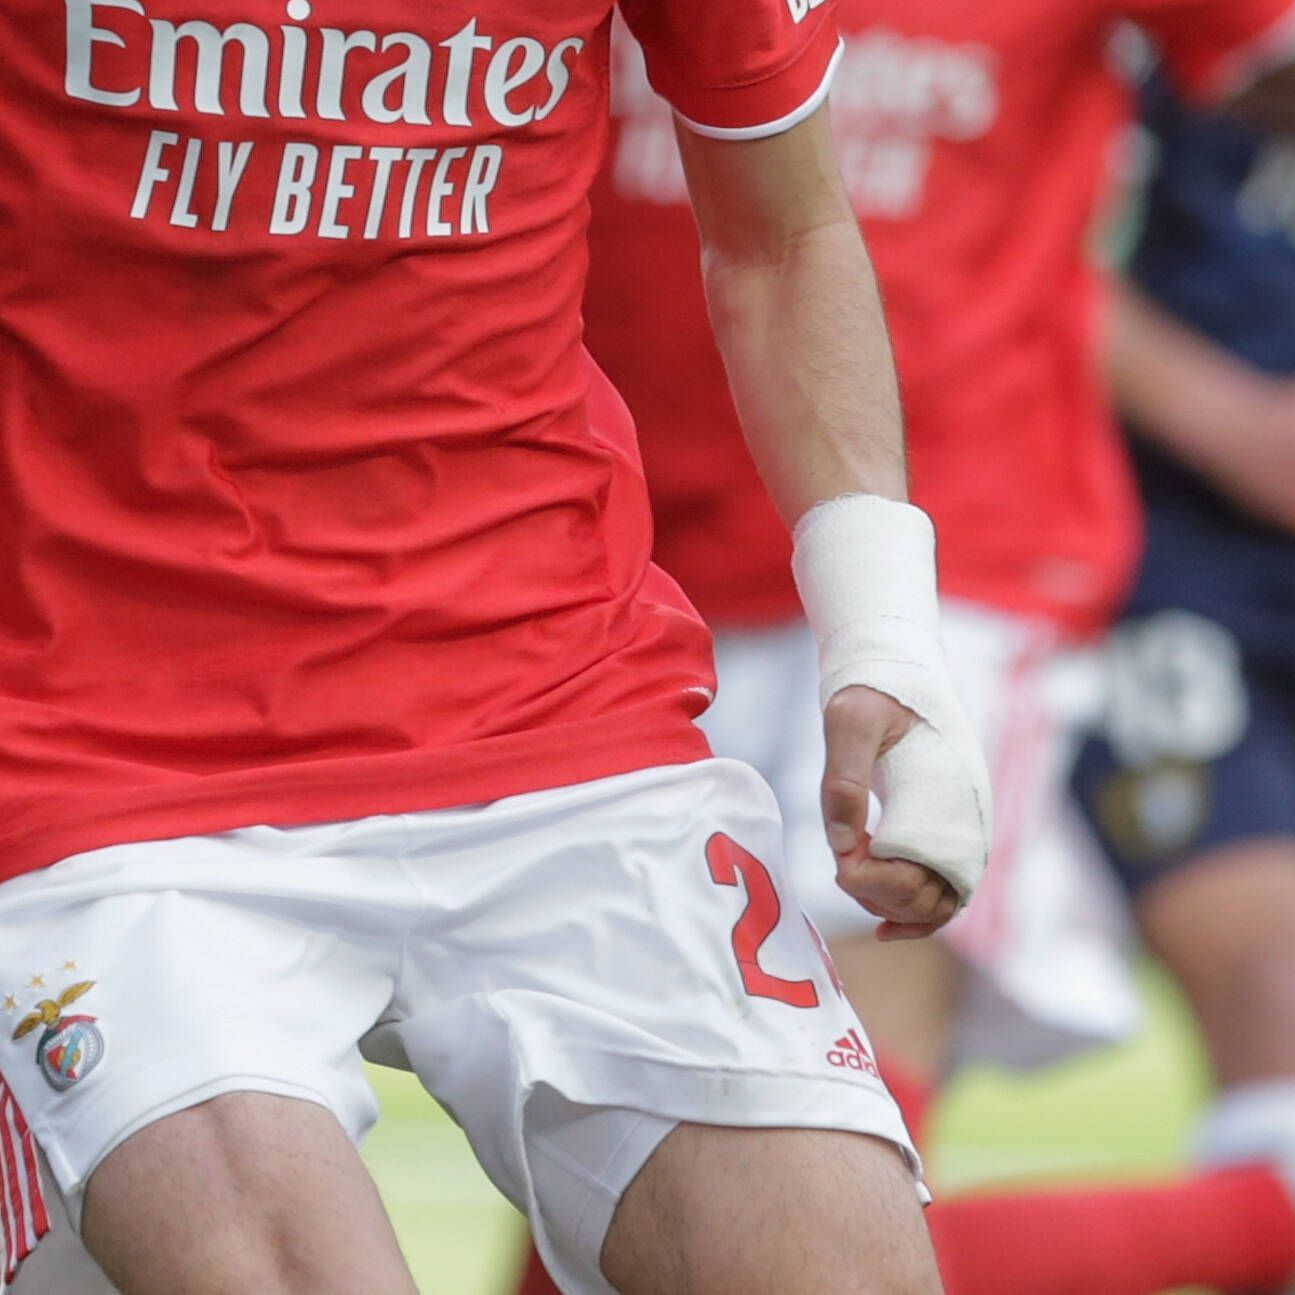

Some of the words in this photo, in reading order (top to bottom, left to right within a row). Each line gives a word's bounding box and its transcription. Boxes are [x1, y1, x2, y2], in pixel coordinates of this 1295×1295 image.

[129, 129, 254, 232] FLY
[269, 142, 503, 240] BETTER
[705, 831, 844, 1009] 2
